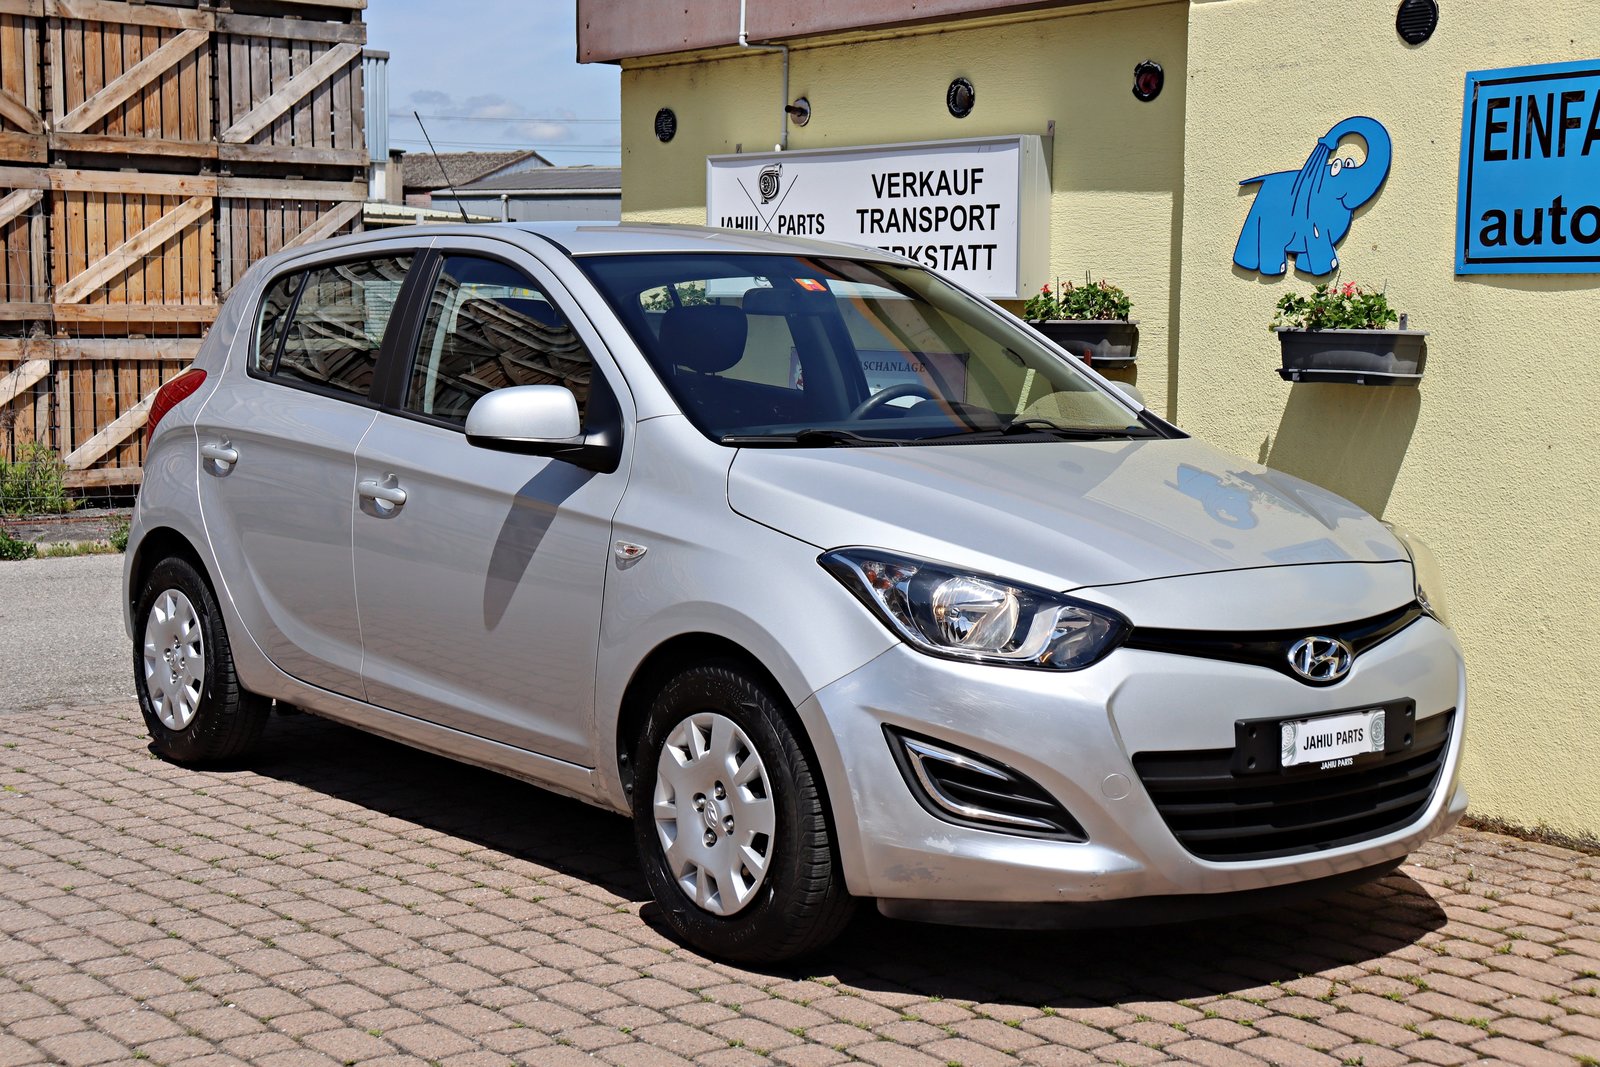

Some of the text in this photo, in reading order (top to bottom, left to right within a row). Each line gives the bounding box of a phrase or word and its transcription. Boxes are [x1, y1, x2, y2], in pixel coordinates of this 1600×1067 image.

[871, 168, 984, 199] VERKAUF
[778, 213, 825, 235] PARTS
[856, 203, 1001, 234] TRANSPORT
[1479, 194, 1600, 247] auto
[863, 360, 926, 373] SCHANLAGE
[1303, 728, 1364, 751] JAHIU PARTS
[1320, 757, 1354, 770] JAHIU PARTS
